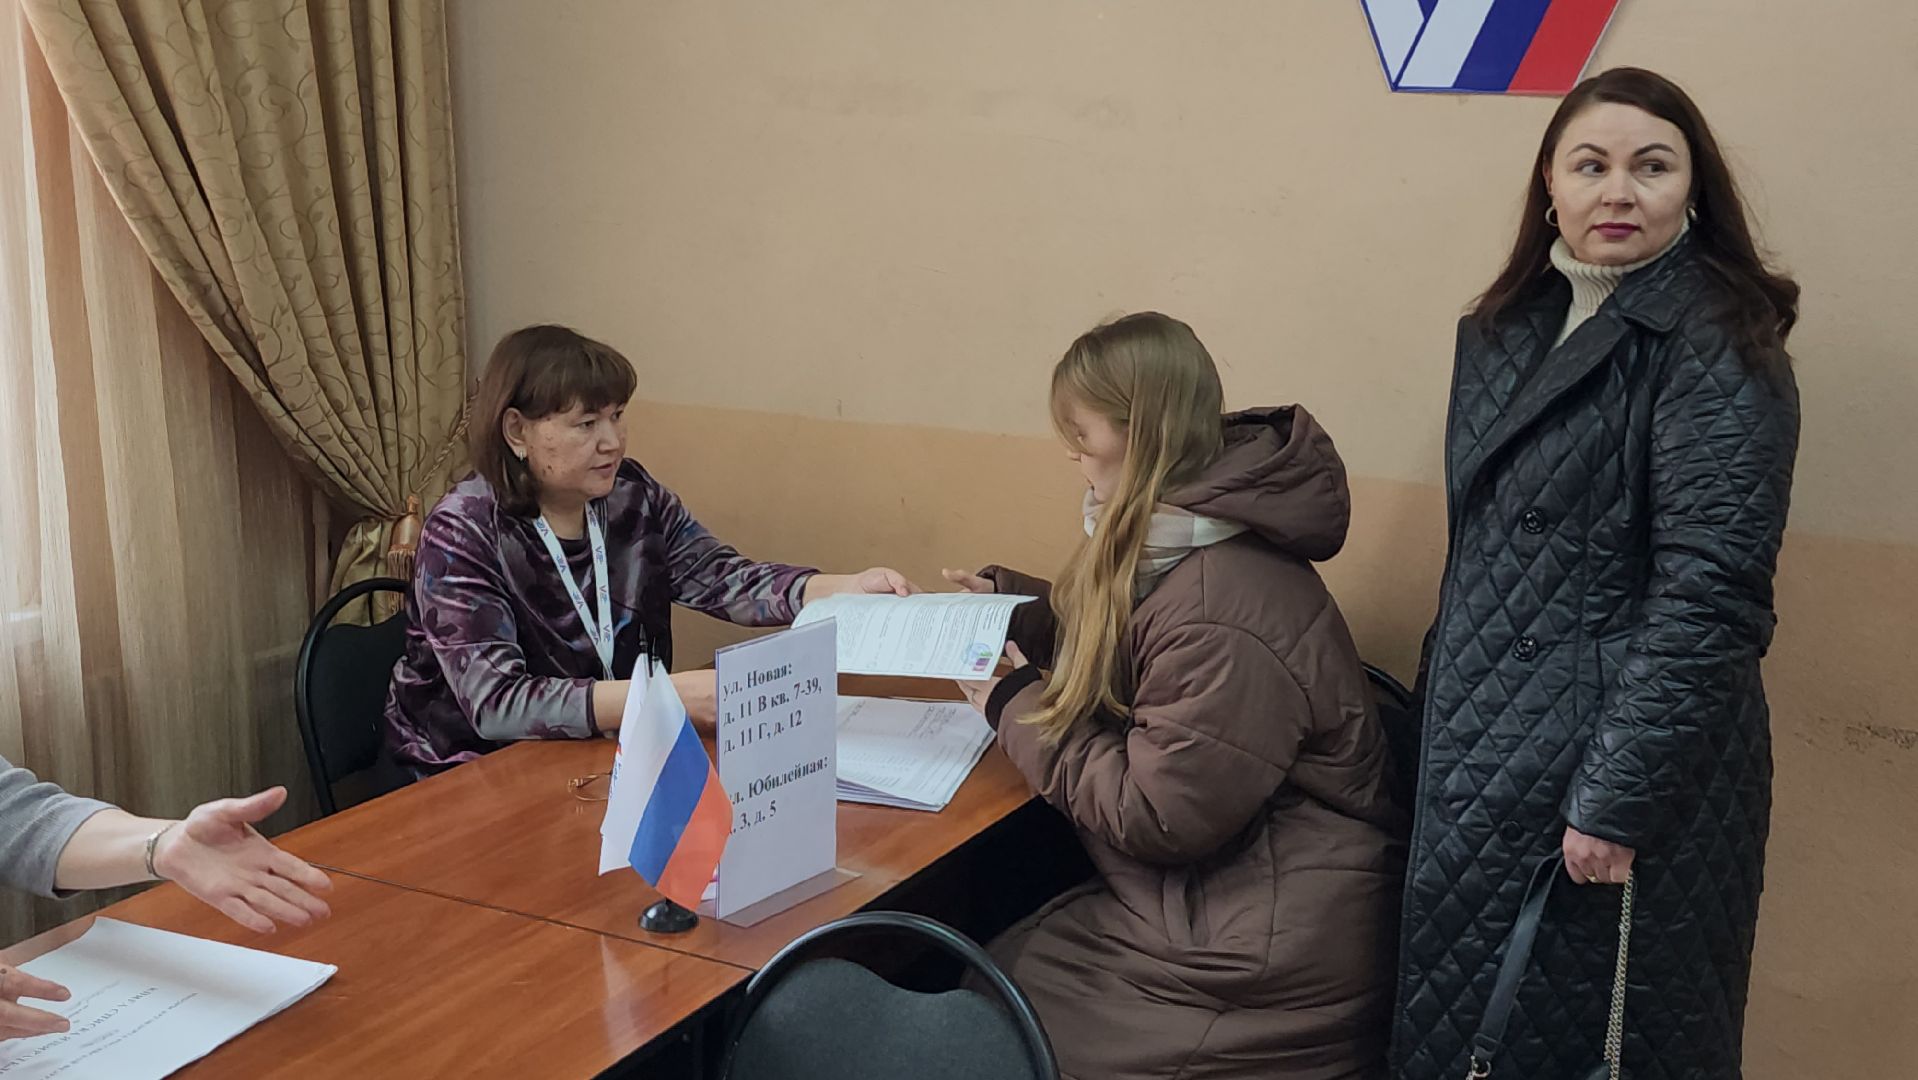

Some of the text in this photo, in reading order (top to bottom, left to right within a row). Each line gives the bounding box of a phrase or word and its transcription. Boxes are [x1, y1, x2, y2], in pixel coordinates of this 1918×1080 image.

[723, 663, 793, 702] ул. Новая:
[723, 677, 822, 727] д. 11 В кв. 7-39,
[723, 709, 803, 755] д. 11 Г, д. 12
[729, 791, 744, 805] л.
[749, 756, 828, 799] Юбилейная:
[739, 812, 751, 830] 3,
[753, 810, 766, 825] д.
[769, 800, 777, 817] 5
